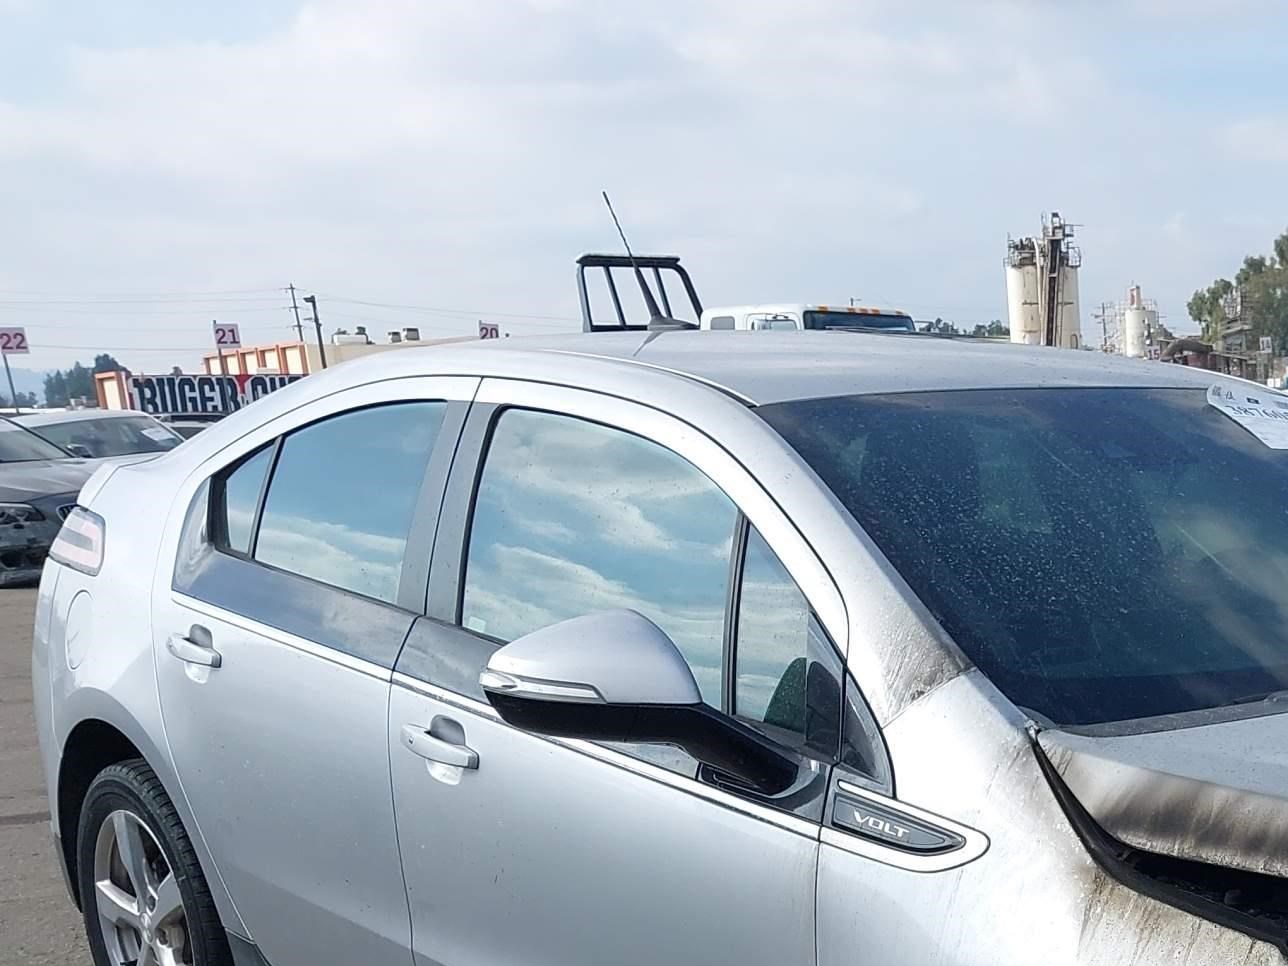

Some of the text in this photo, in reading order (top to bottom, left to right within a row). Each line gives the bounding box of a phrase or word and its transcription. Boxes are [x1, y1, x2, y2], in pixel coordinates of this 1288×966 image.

[0, 333, 28, 350] 22
[216, 328, 240, 344] 21
[854, 808, 910, 838] VOLT
